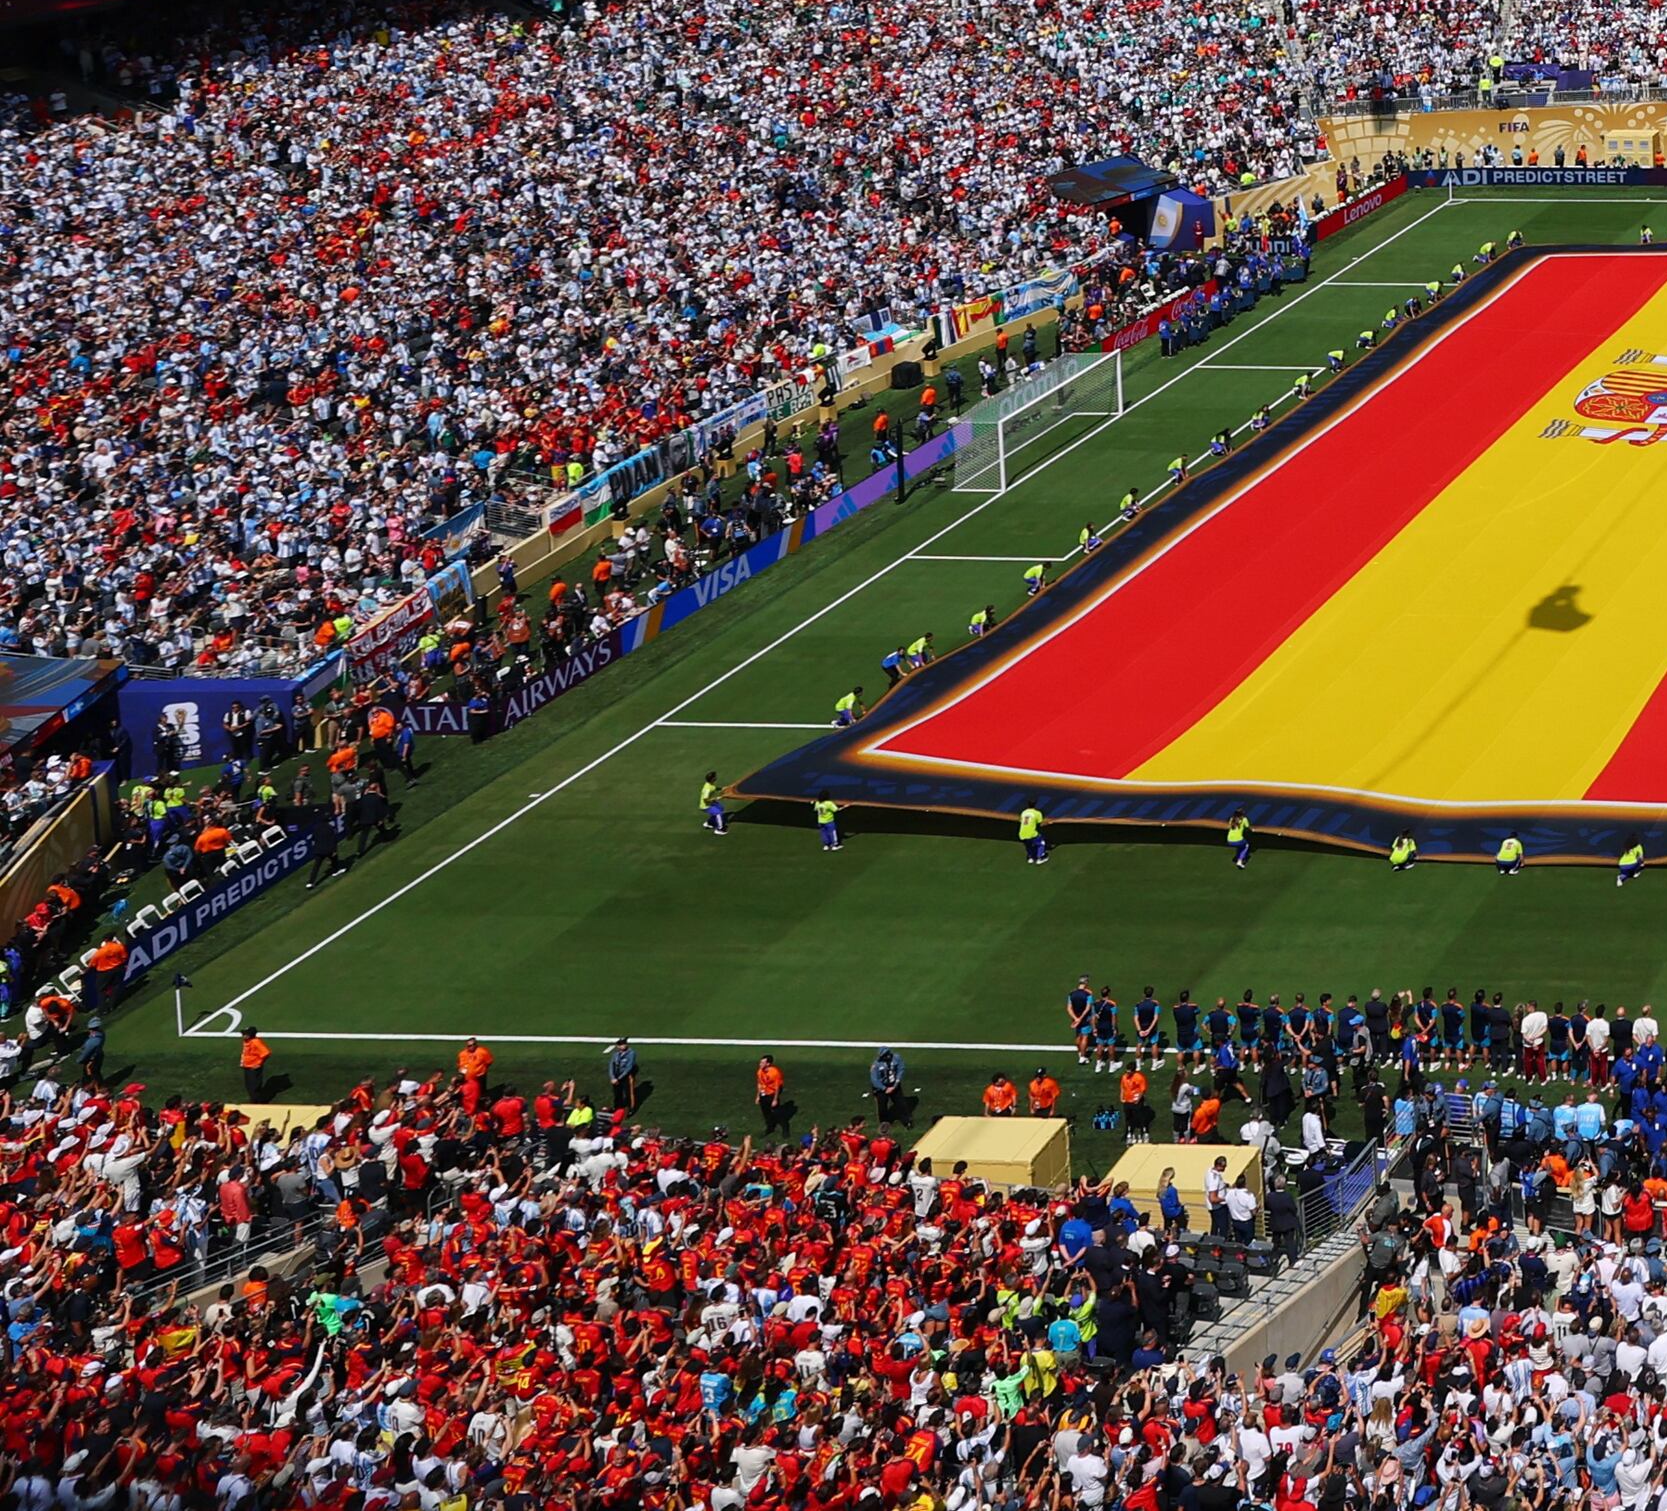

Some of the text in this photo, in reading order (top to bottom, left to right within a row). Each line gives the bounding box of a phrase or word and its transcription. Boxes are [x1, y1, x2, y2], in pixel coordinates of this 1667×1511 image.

[1499, 122, 1530, 133] FIFA
[1442, 169, 1627, 186] ADI PREDICTSTREET
[1343, 193, 1383, 225] Lenovo
[1113, 316, 1150, 350] Coca-Cola
[694, 553, 752, 608] VISA
[504, 638, 613, 727] AIRWAYS
[123, 914, 189, 981] ADI
[708, 1318, 727, 1332] 16
